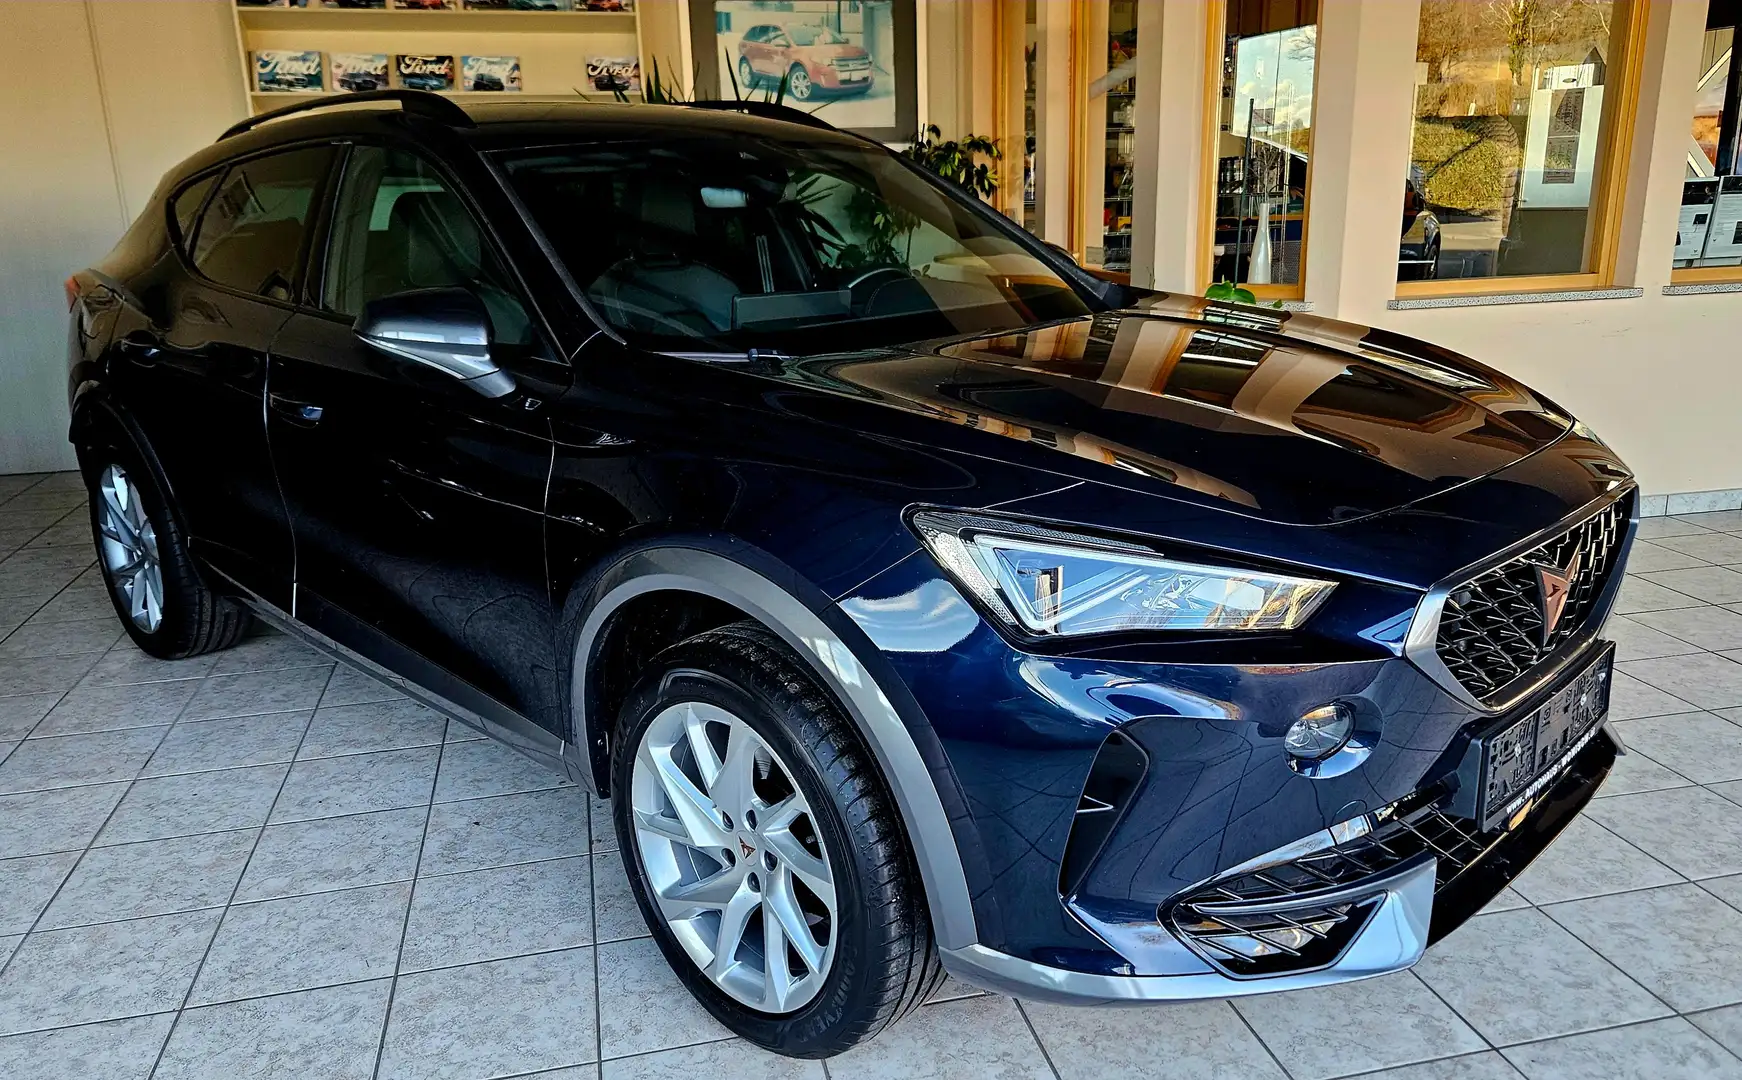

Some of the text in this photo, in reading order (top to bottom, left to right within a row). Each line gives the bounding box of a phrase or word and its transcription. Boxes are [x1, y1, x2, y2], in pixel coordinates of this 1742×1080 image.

[256, 51, 320, 74] Ford
[331, 54, 387, 74] Ford
[400, 56, 451, 75] Ford
[464, 57, 518, 75] Ford
[588, 58, 637, 77] Ford
